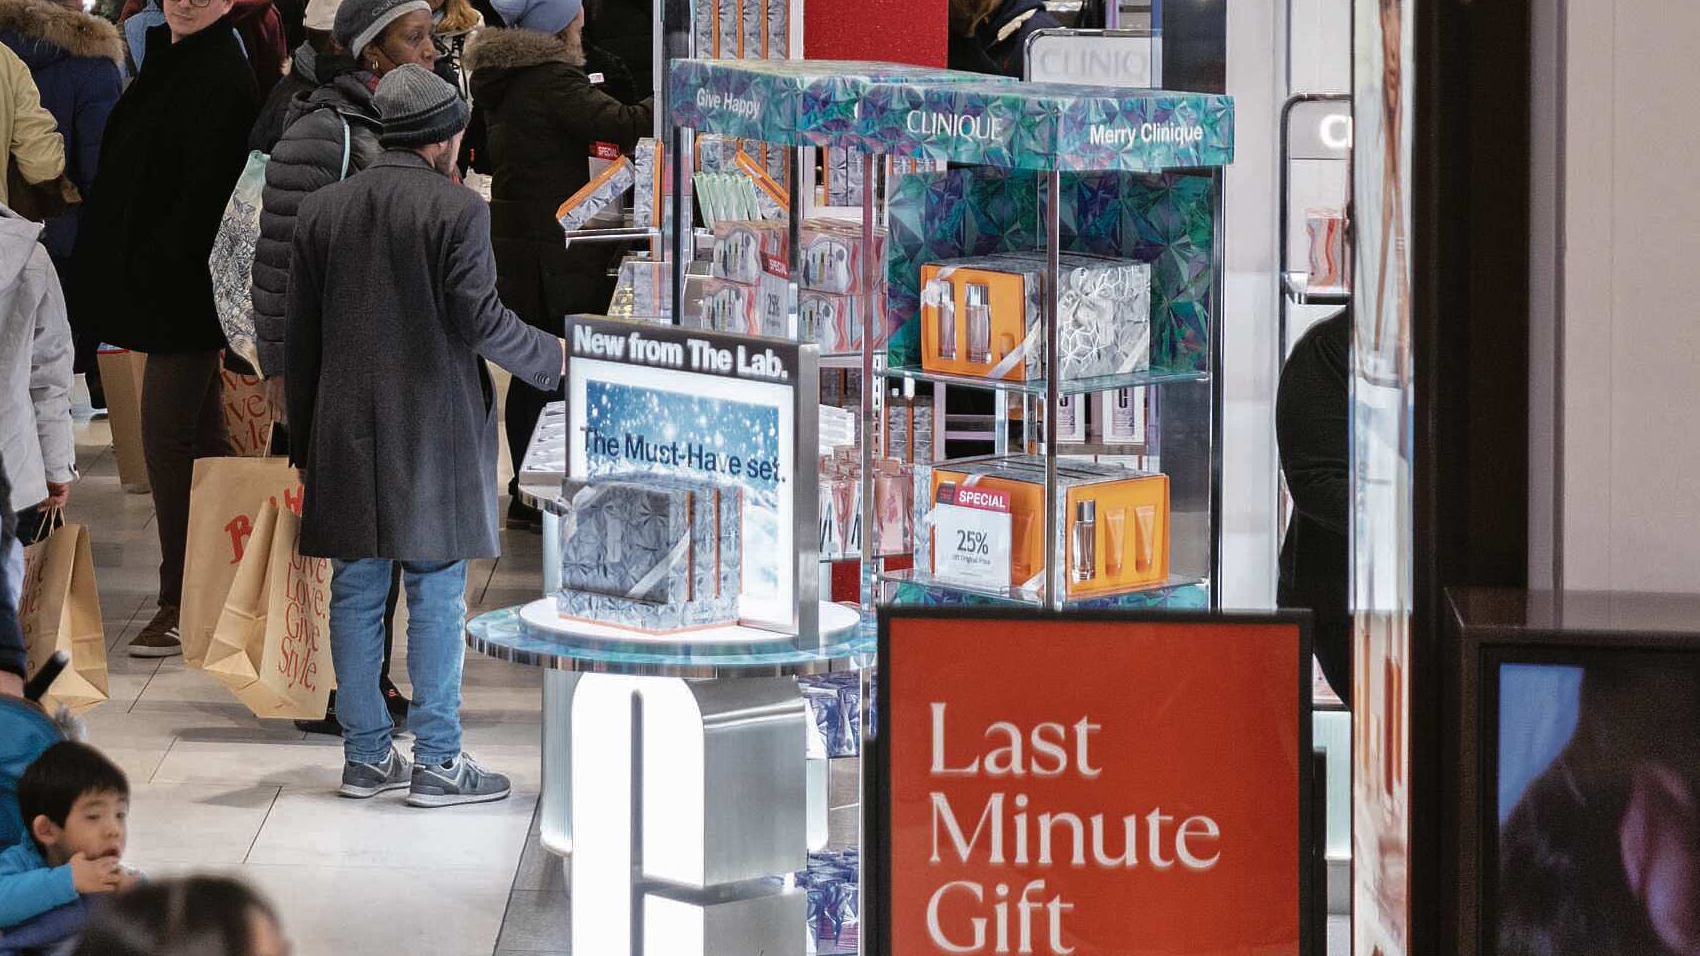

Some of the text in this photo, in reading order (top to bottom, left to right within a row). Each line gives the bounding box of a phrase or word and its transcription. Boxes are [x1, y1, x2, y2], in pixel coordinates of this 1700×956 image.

[696, 87, 761, 120] Give Happy
[907, 109, 1003, 143] CLINIQUE
[1090, 123, 1204, 149] Merry Clinique
[574, 324, 788, 380] New from The Lab.
[580, 426, 620, 457] The
[746, 456, 787, 484] set.
[959, 490, 1006, 508] SPECIAL
[956, 529, 989, 555] 25%
[286, 562, 327, 620] Love.
[285, 601, 320, 653] Give
[279, 636, 317, 693] Style.
[929, 702, 1103, 777] Last
[929, 791, 1222, 870] Minute
[925, 878, 1077, 956] Gift
